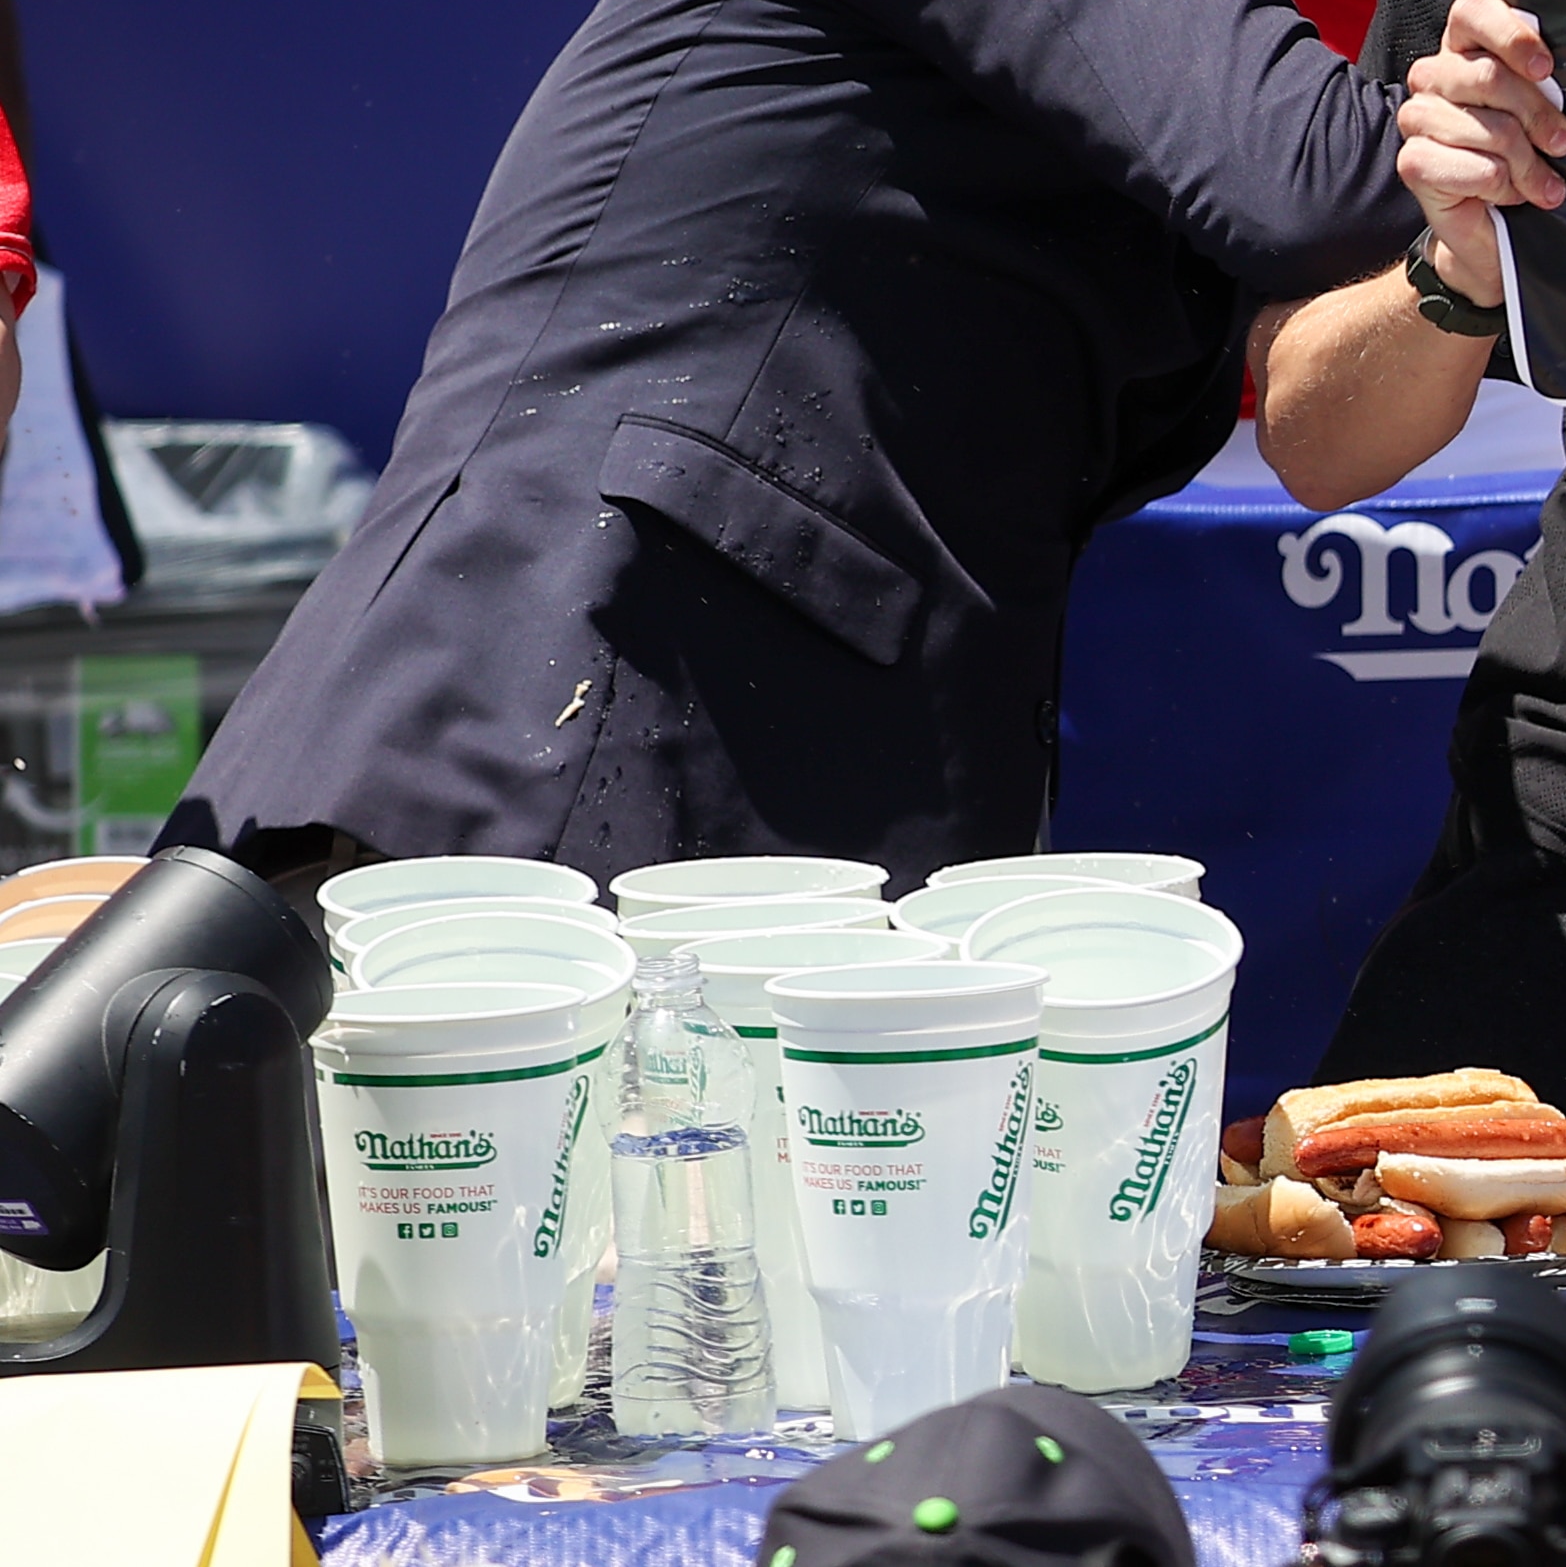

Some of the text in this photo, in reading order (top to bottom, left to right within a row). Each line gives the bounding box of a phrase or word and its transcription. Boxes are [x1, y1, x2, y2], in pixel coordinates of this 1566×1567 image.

[798, 1105, 926, 1137] Nathan's
[354, 1129, 498, 1161] Nathan's
[969, 1062, 1034, 1240] Nathan's
[1109, 1058, 1198, 1222] Nathan's
[818, 1163, 842, 1176] OUR
[844, 1164, 883, 1177] FOOD
[886, 1163, 923, 1176] THAT
[358, 1184, 495, 1200] IT'S OUR FOOD THAT
[837, 1179, 853, 1191] US
[359, 1202, 400, 1214] MAKES
[403, 1203, 421, 1215] US
